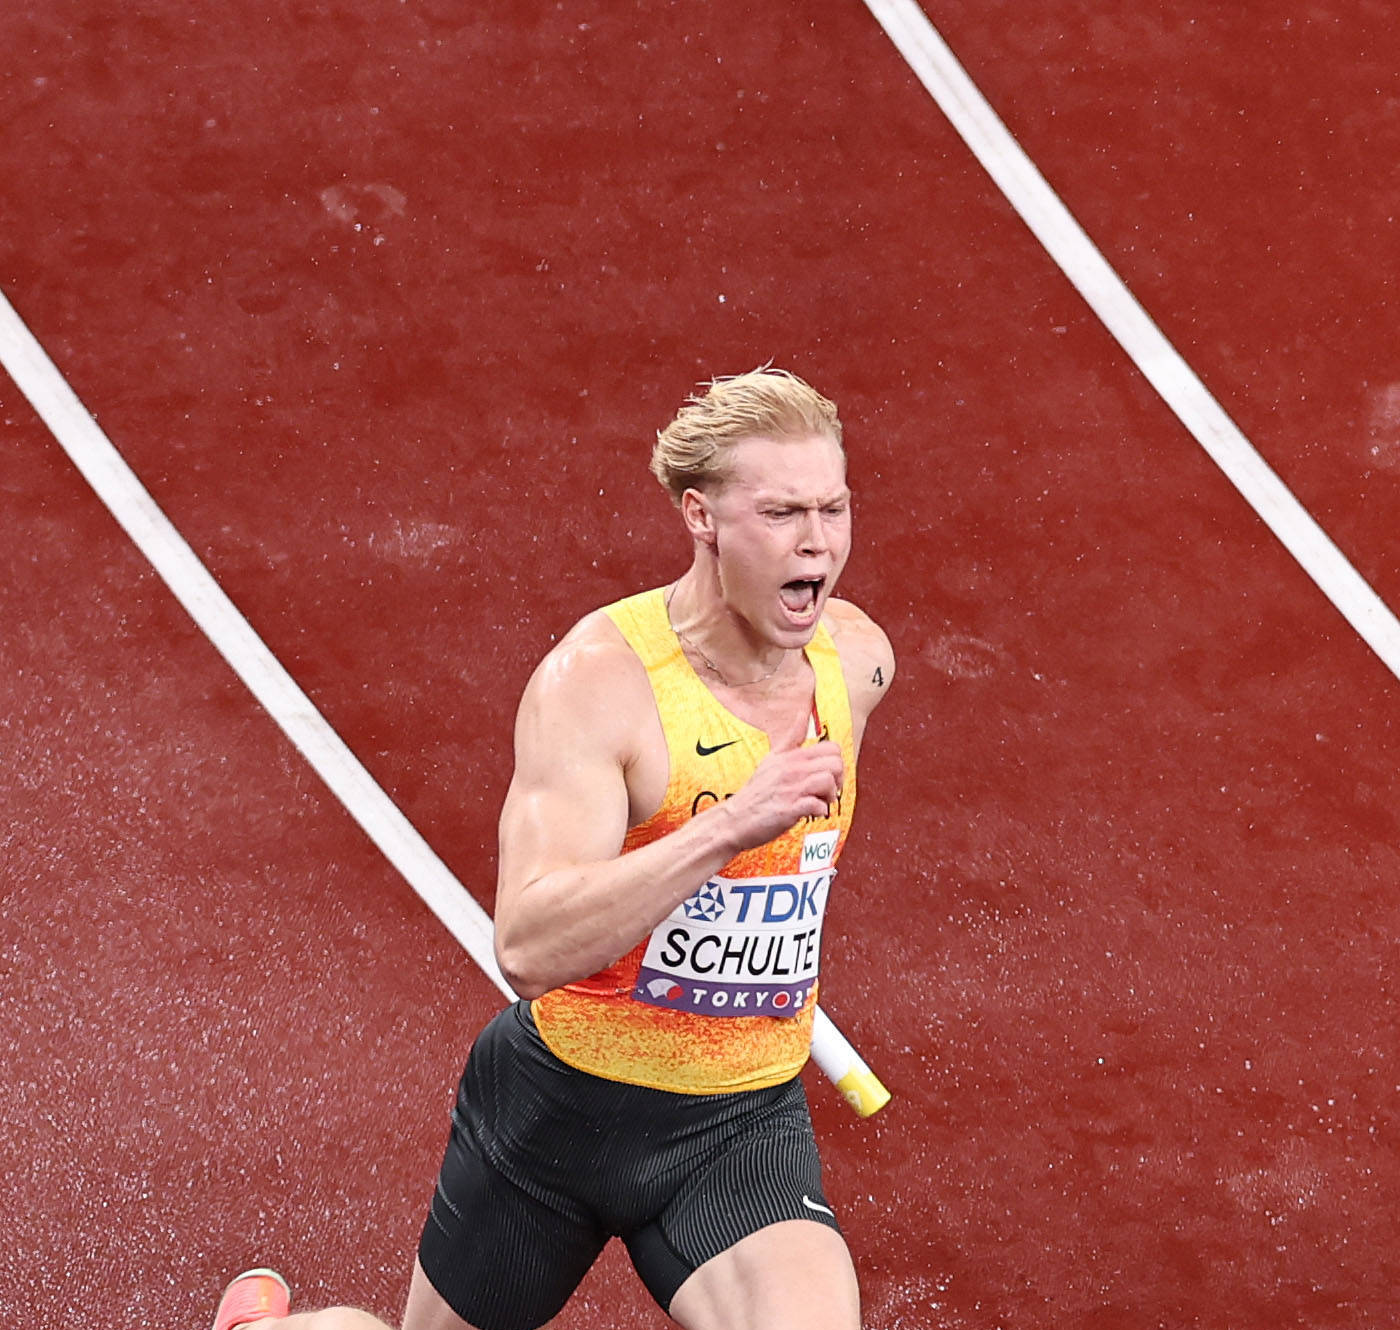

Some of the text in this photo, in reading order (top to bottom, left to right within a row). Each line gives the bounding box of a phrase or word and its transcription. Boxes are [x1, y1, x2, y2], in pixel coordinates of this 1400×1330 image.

[871, 666, 884, 687] 4
[730, 876, 825, 923] TDK
[660, 928, 817, 976] SCHULTE
